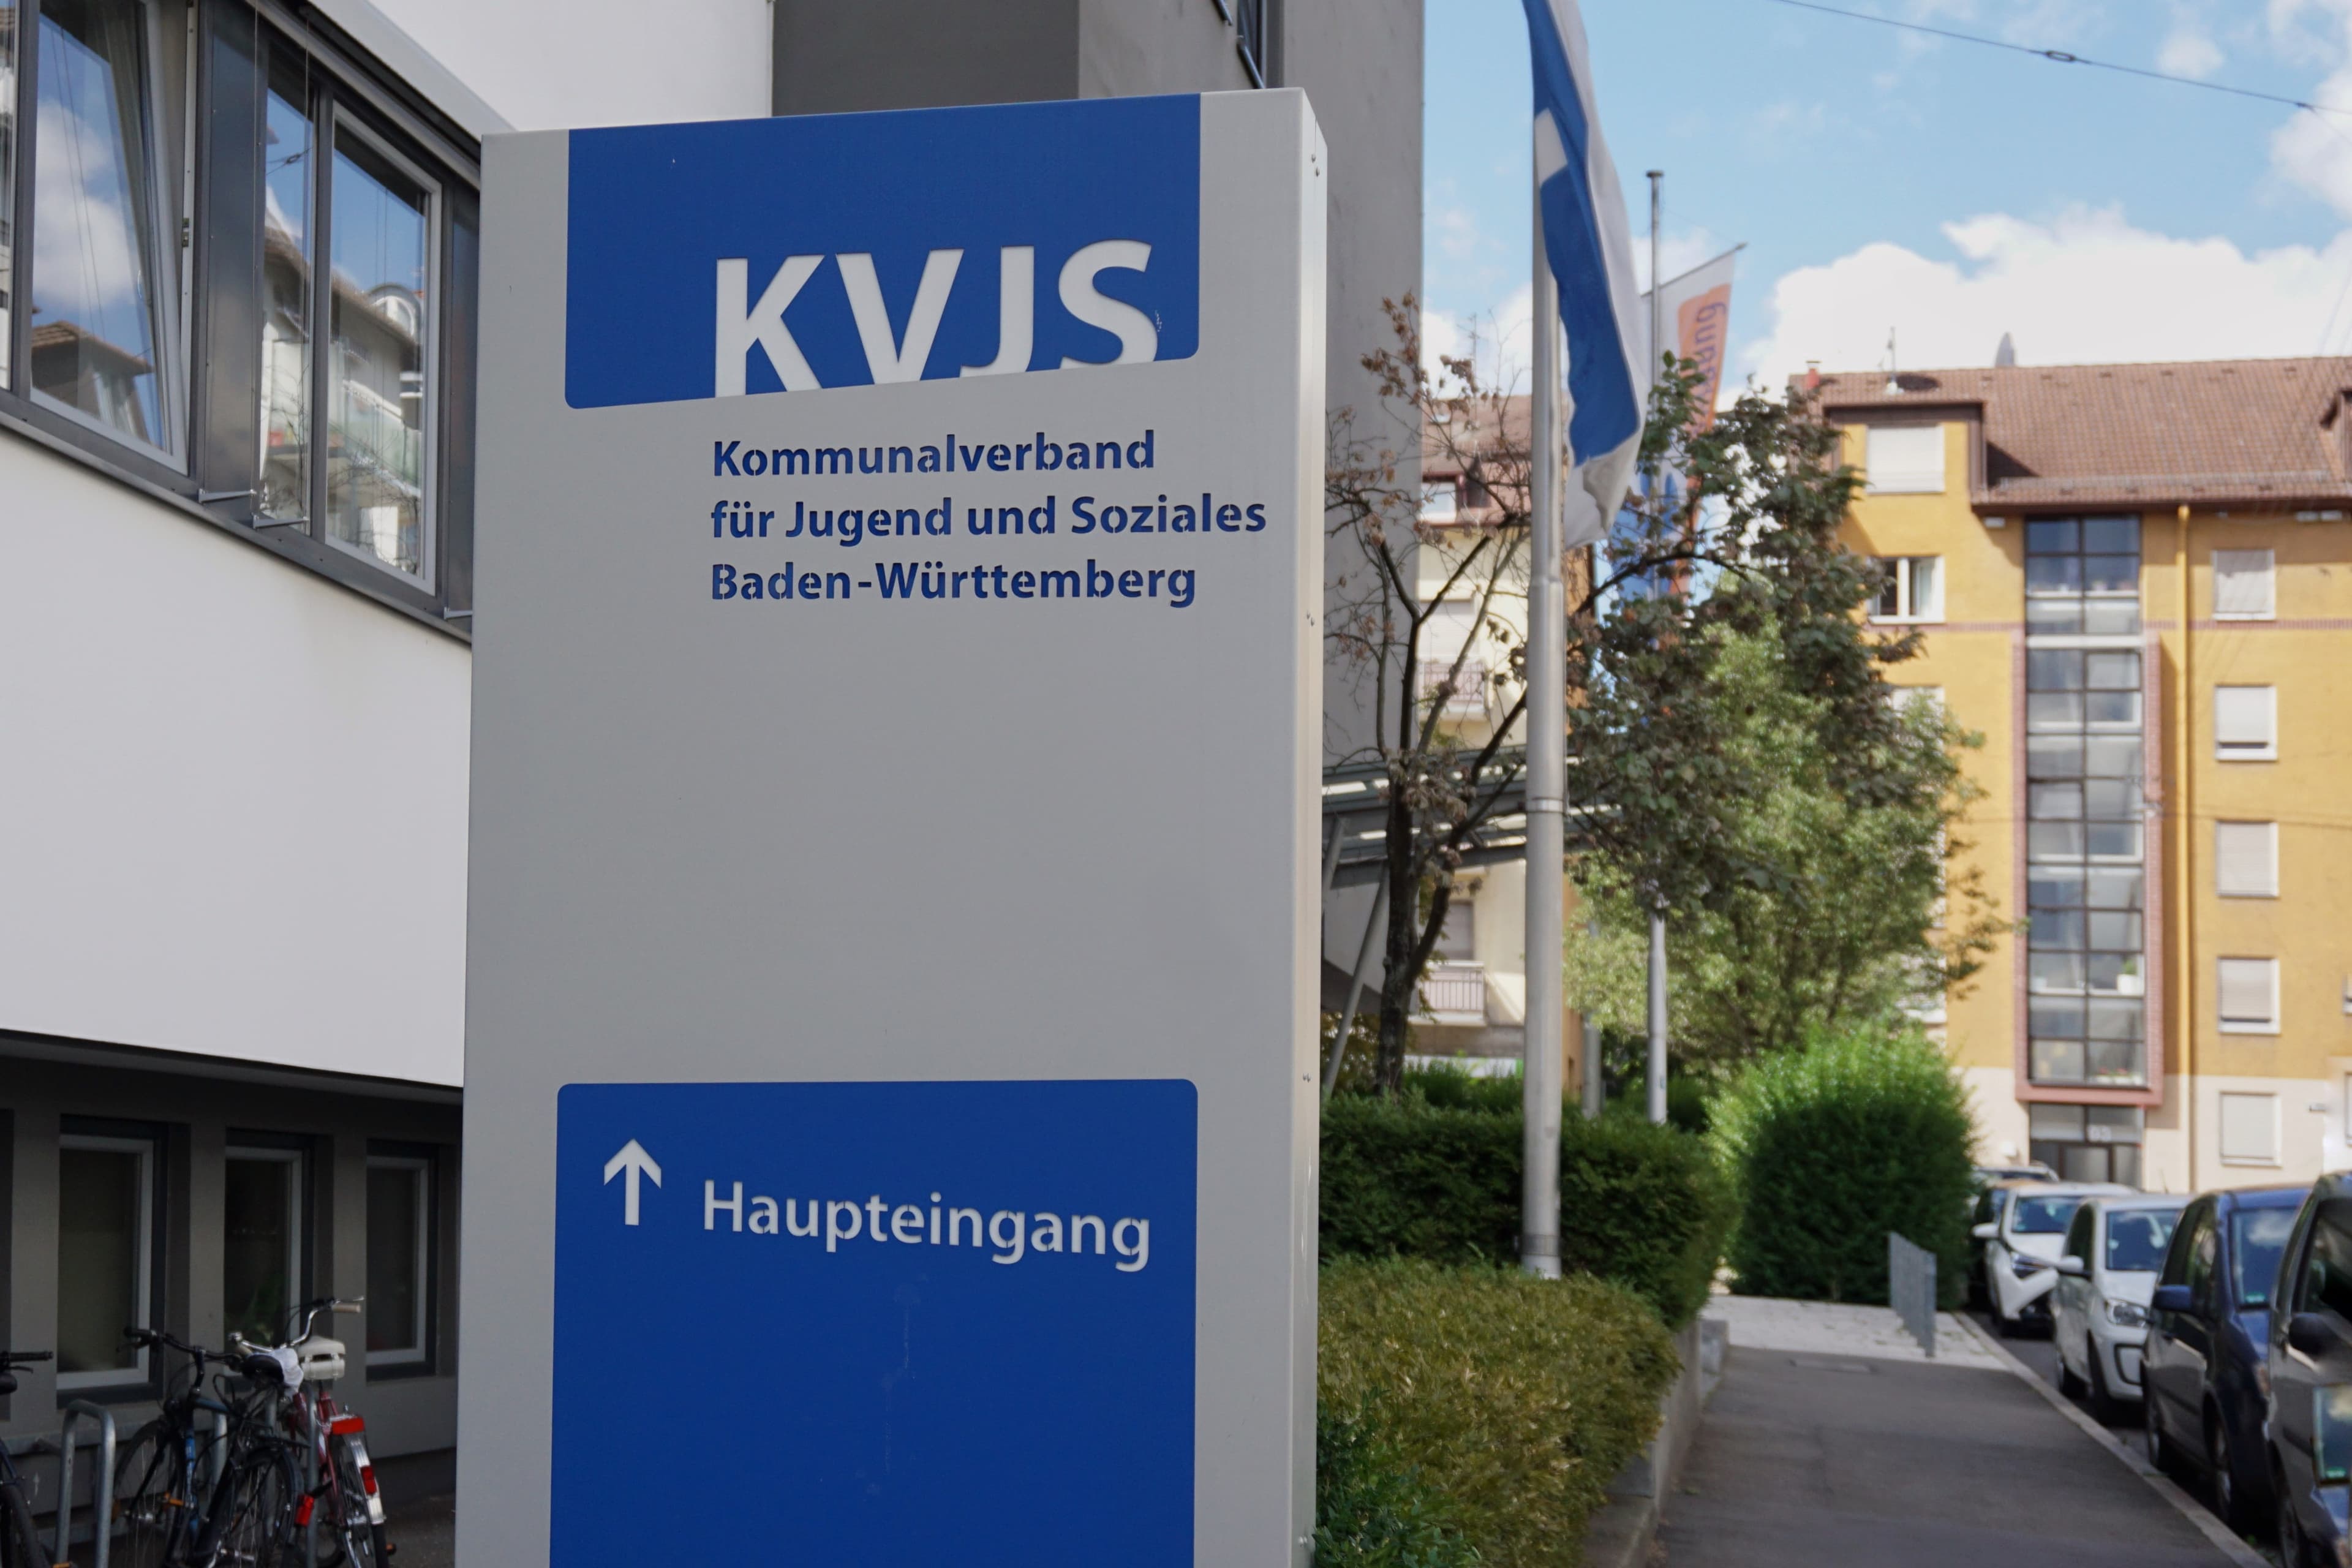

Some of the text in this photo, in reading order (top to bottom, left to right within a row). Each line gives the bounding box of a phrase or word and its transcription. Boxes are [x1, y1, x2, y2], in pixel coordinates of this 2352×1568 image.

[715, 239, 1158, 398] KVJS
[714, 429, 1155, 477] Kommunalverband
[711, 494, 1267, 547] für Jugend und Soziales
[712, 559, 1196, 608] Baden-Württemberg
[704, 1180, 1150, 1273] Haupteingang
